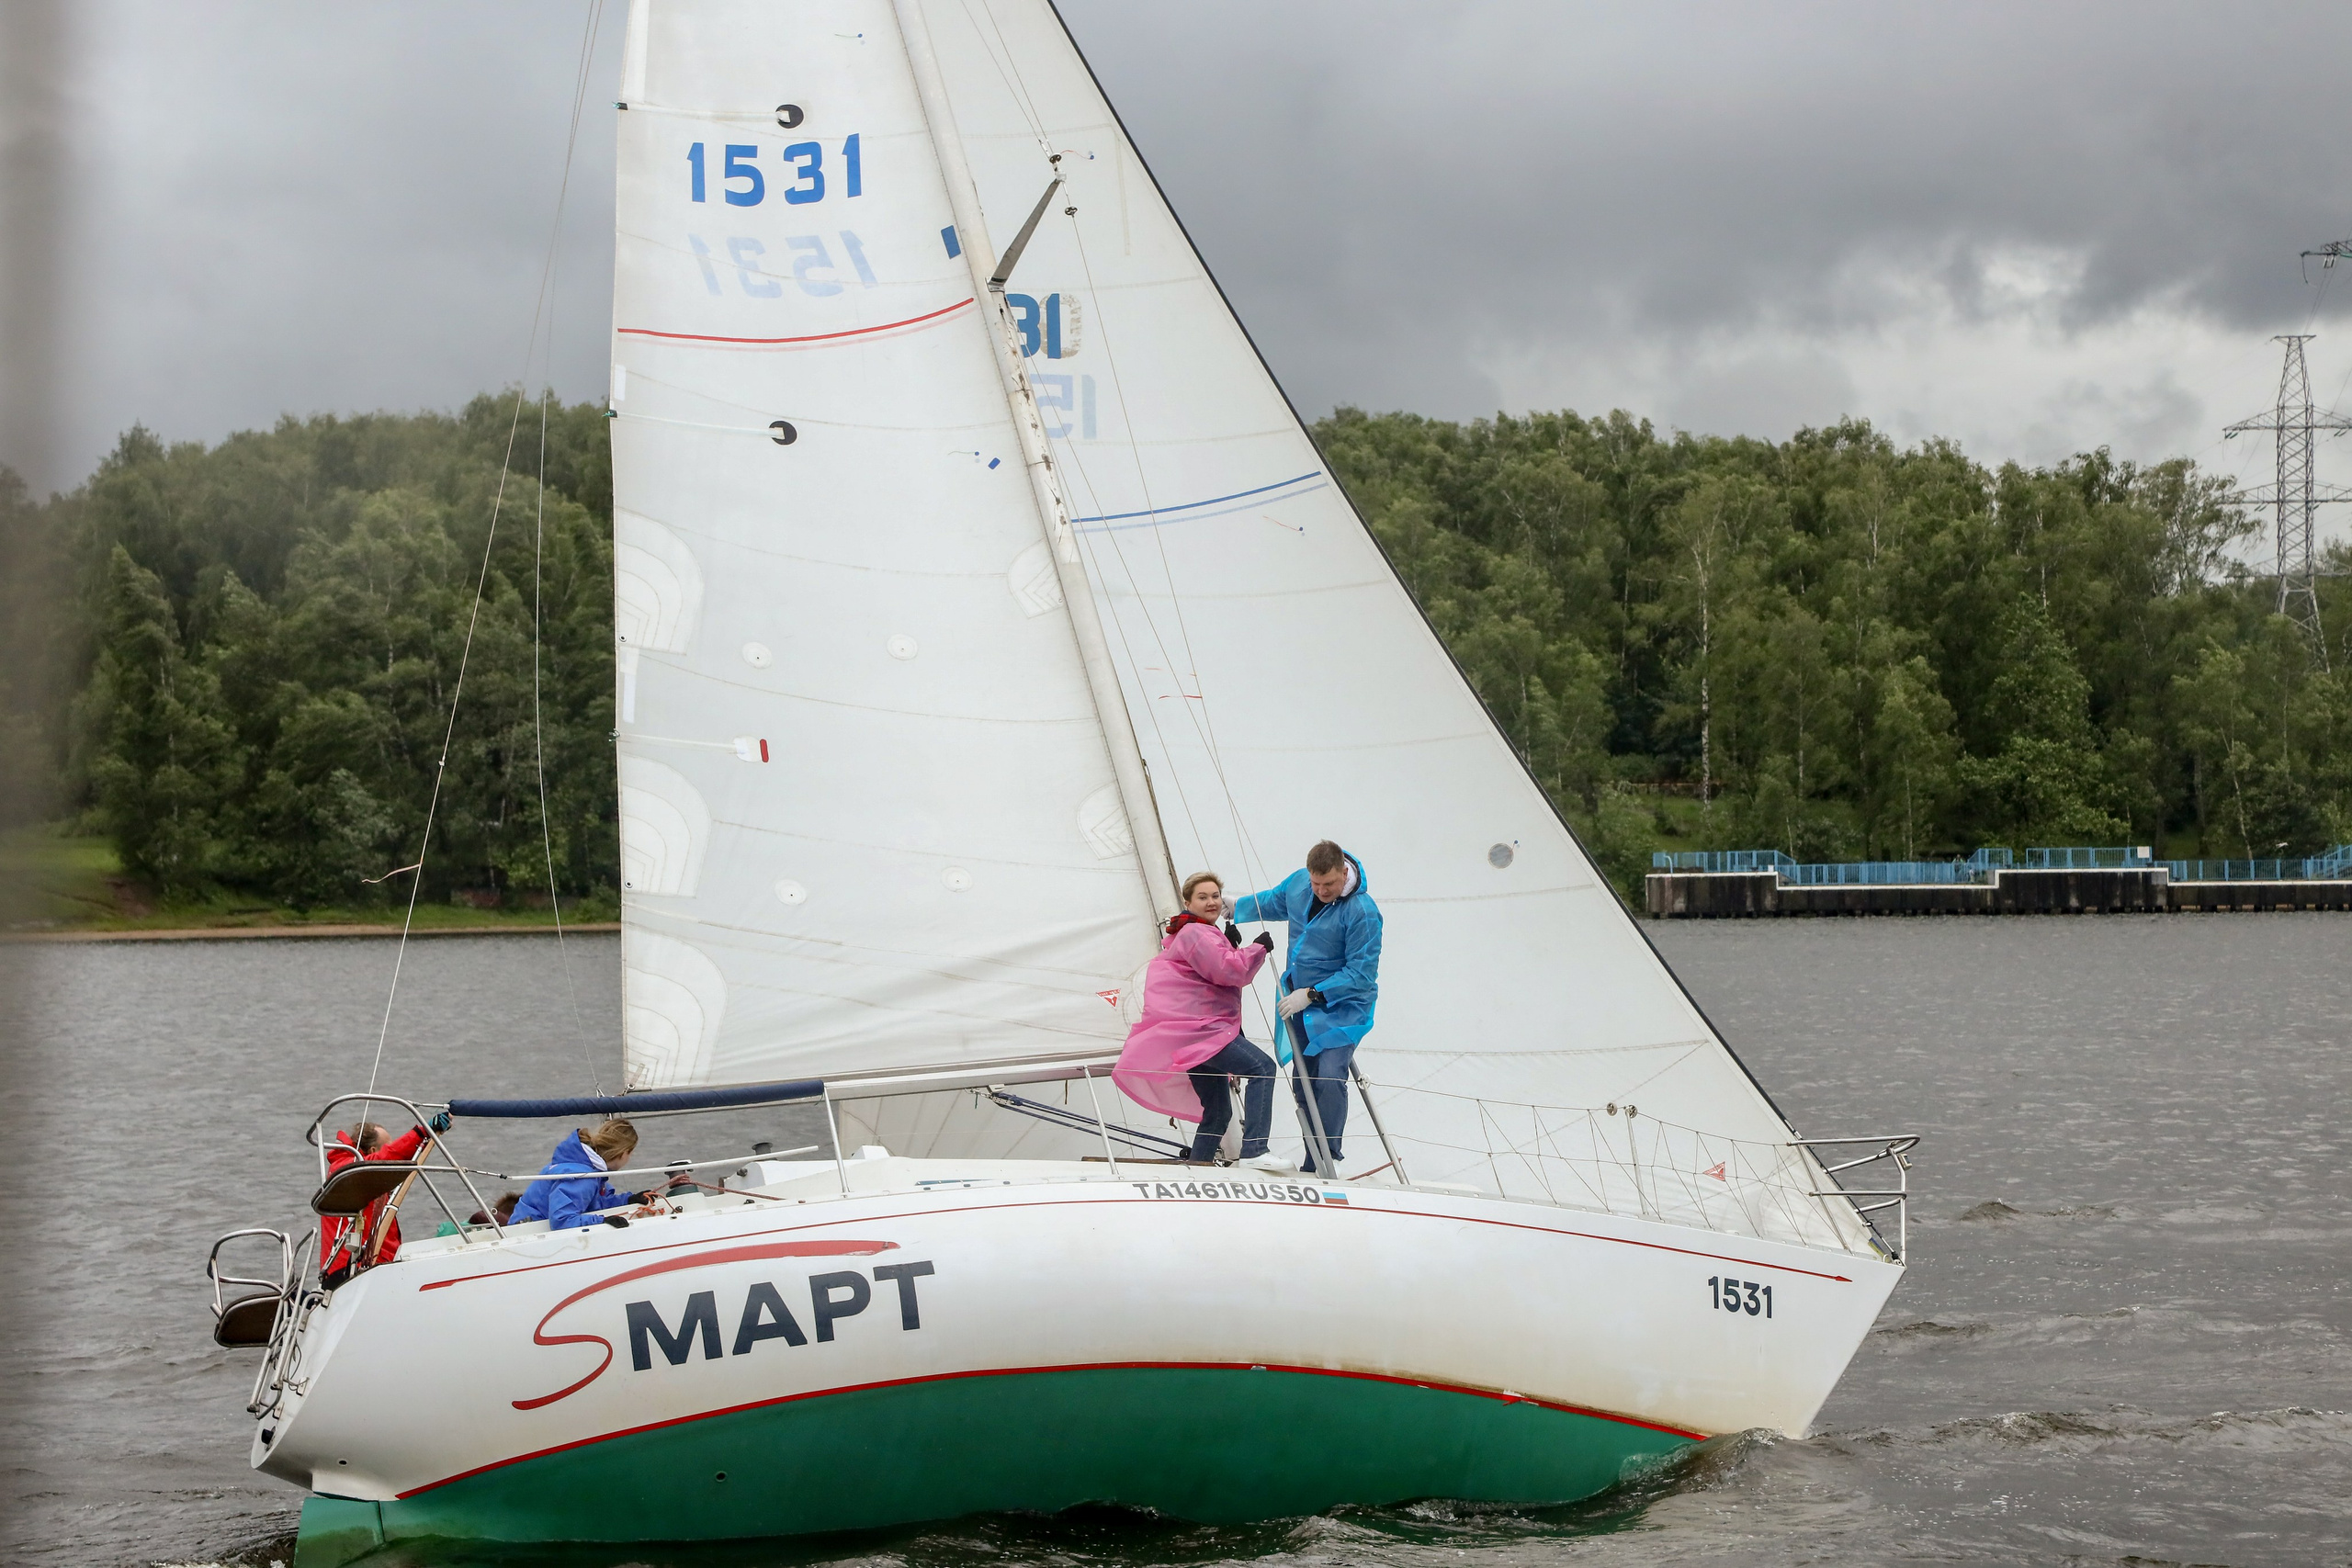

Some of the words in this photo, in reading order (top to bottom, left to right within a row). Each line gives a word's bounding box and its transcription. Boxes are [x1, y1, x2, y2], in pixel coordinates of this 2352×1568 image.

[686, 133, 862, 207] 1531
[1132, 1182, 1321, 1204] TA1461RUS50
[1708, 1275, 1772, 1319] 1531
